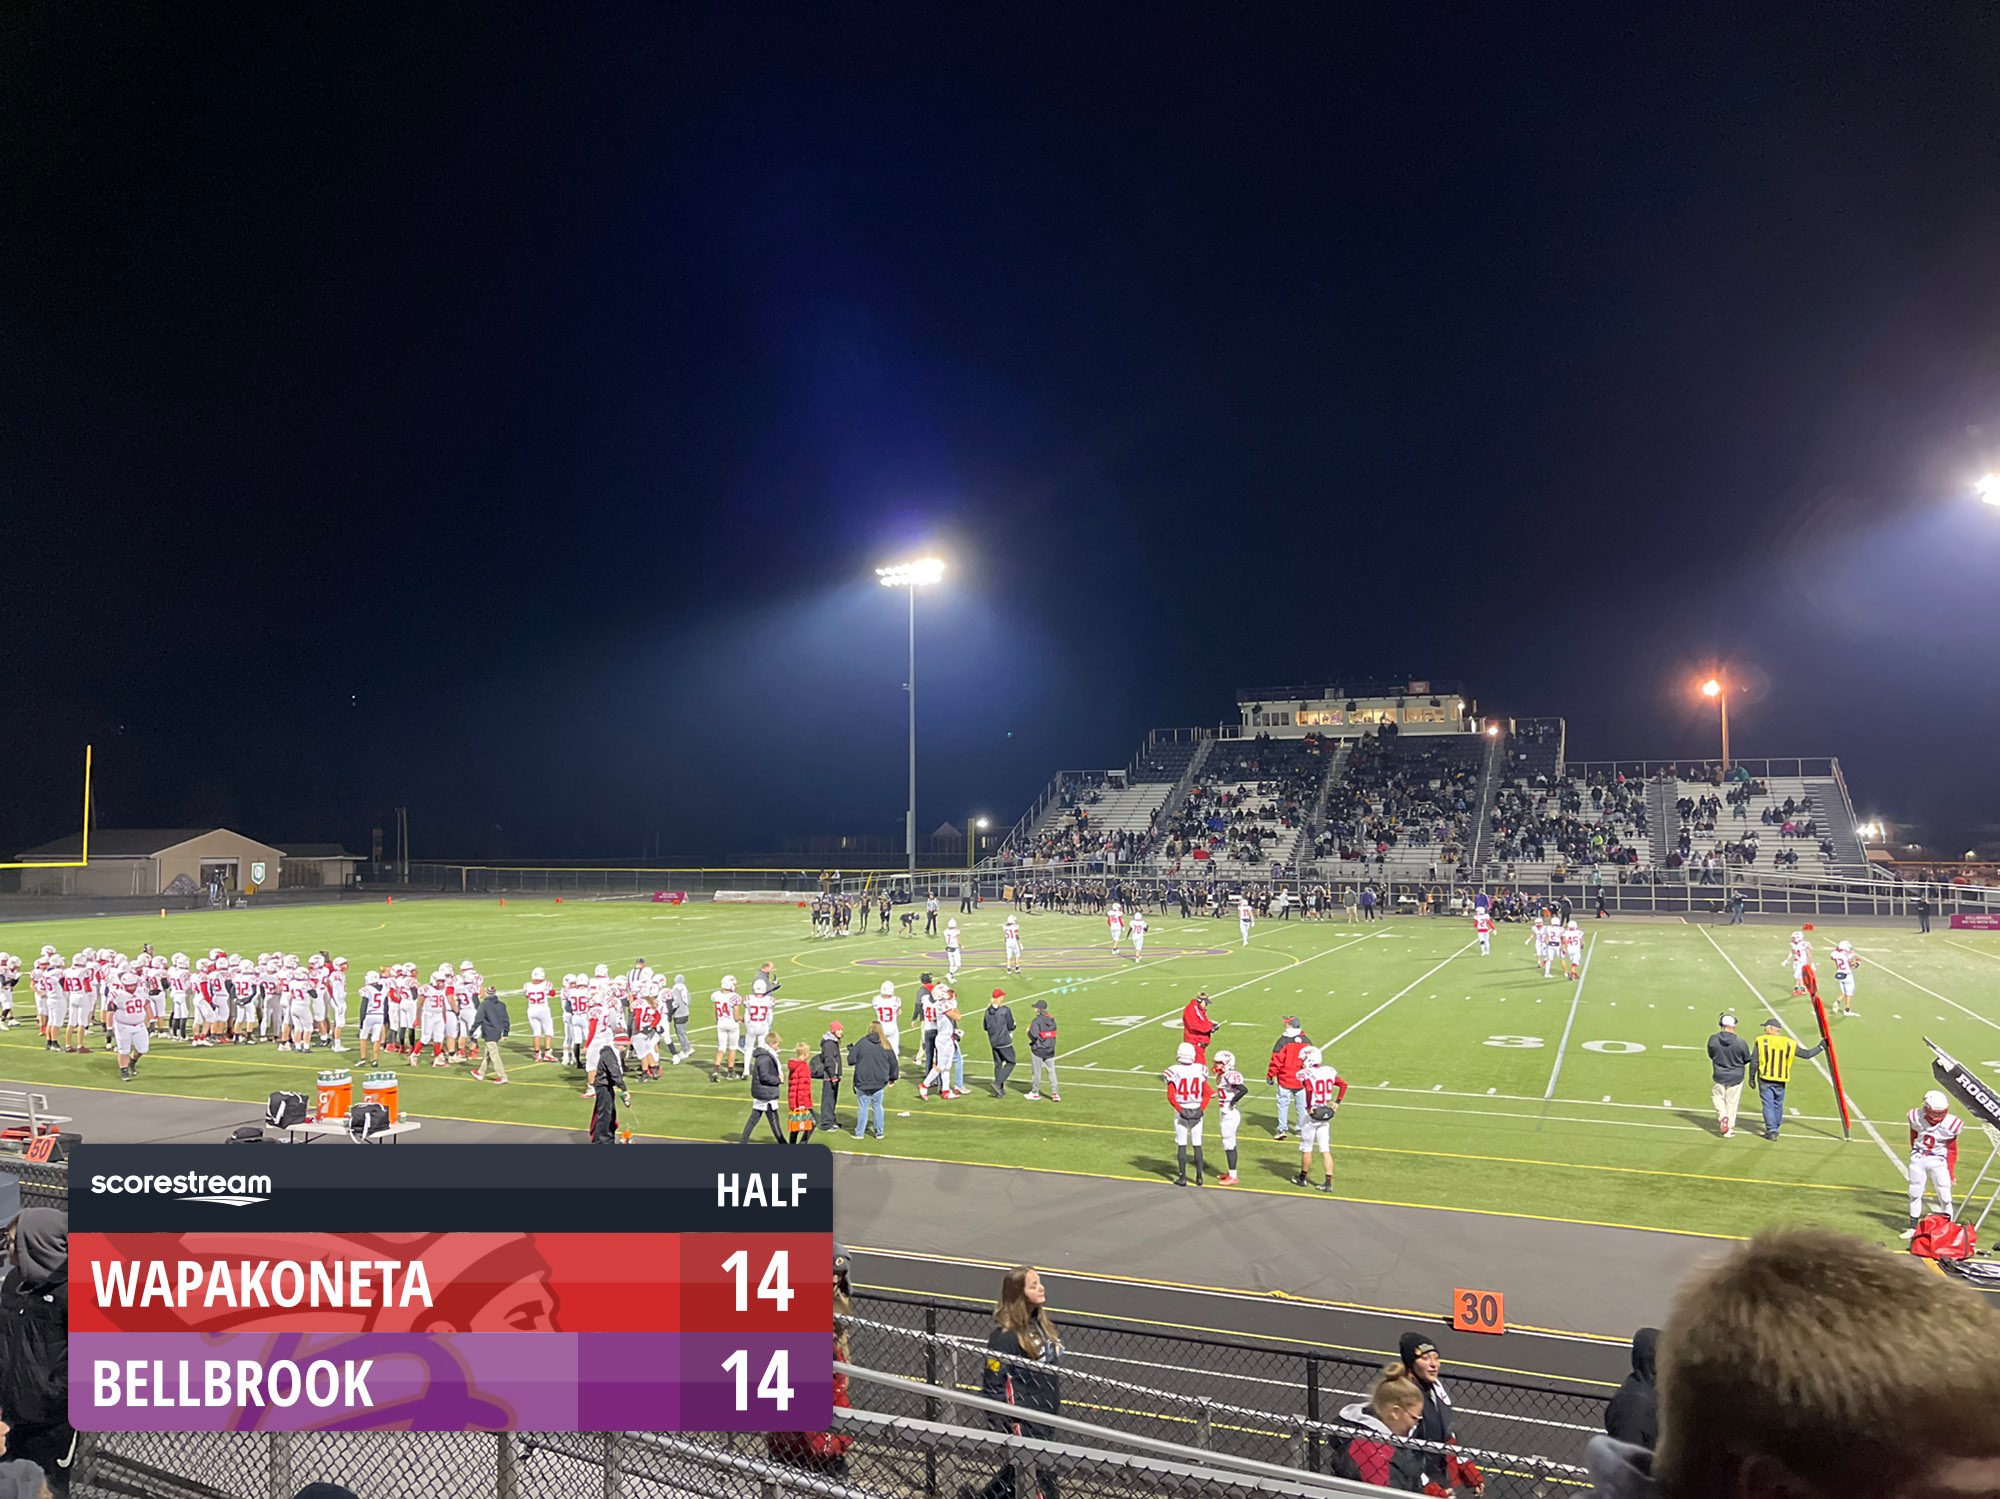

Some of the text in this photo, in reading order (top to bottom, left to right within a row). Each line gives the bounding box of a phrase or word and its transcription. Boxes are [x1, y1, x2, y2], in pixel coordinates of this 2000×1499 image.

[126, 999, 143, 1014] 69
[571, 996, 587, 1012] 36
[750, 1005, 768, 1022] 23
[877, 1006, 893, 1023] 13
[1177, 1077, 1201, 1102] 44
[1315, 1078, 1333, 1105] 99
[30, 1138, 51, 1159] 50
[1461, 1292, 1498, 1327] 30
